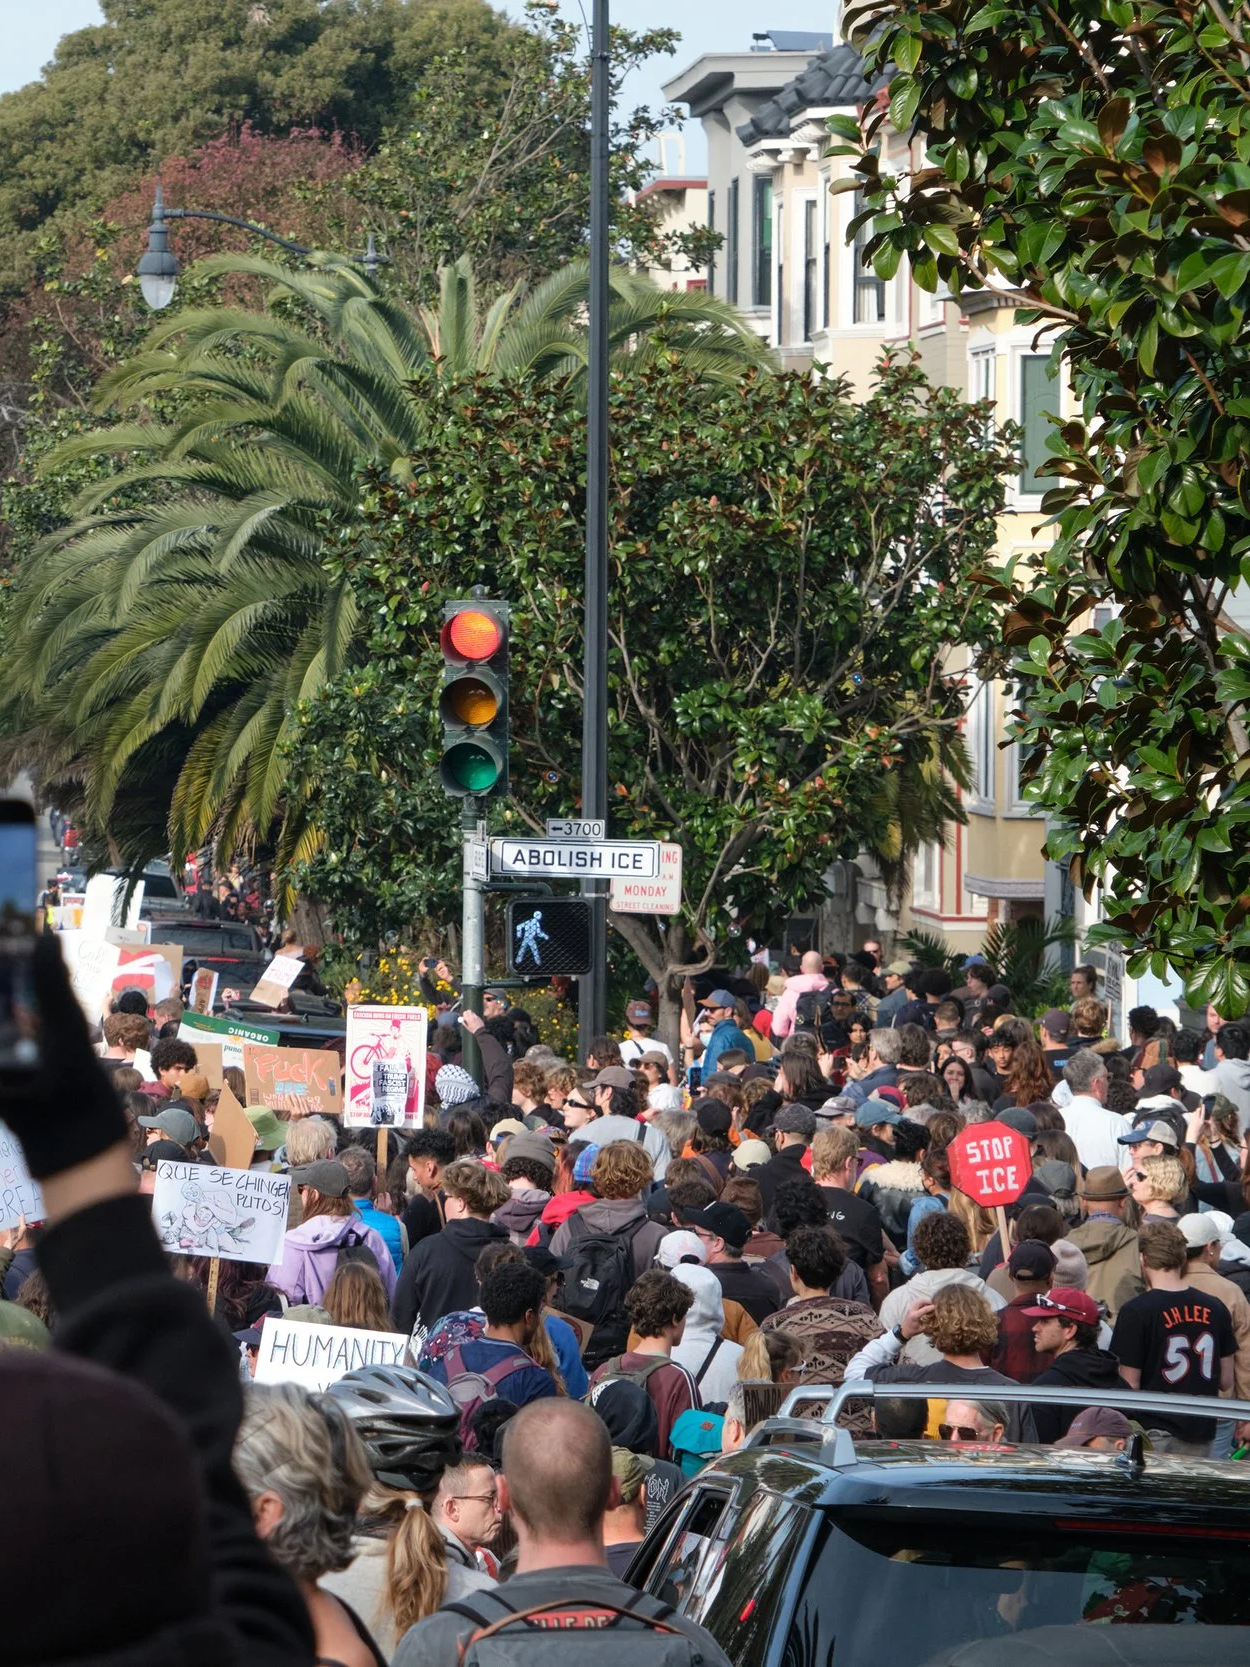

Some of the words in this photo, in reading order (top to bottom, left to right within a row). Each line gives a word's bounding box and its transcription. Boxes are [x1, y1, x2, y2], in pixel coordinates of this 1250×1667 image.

[564, 822, 601, 836] 3700
[512, 849, 602, 869] ABOLISH
[612, 853, 643, 870] ICE
[661, 851, 678, 865] ING
[624, 885, 667, 897] MONDAY
[616, 901, 641, 909] STREET
[642, 903, 674, 911] CLEANING
[228, 1027, 270, 1043] ORGANIC
[378, 1079, 406, 1087] FASCIST
[966, 1136, 1013, 1163] STOP
[158, 1162, 200, 1181] QUE
[210, 1169, 233, 1186] SE
[976, 1166, 1019, 1195] ICE
[270, 1330, 405, 1371] HUMANITY
[1162, 1330, 1215, 1384] 51
